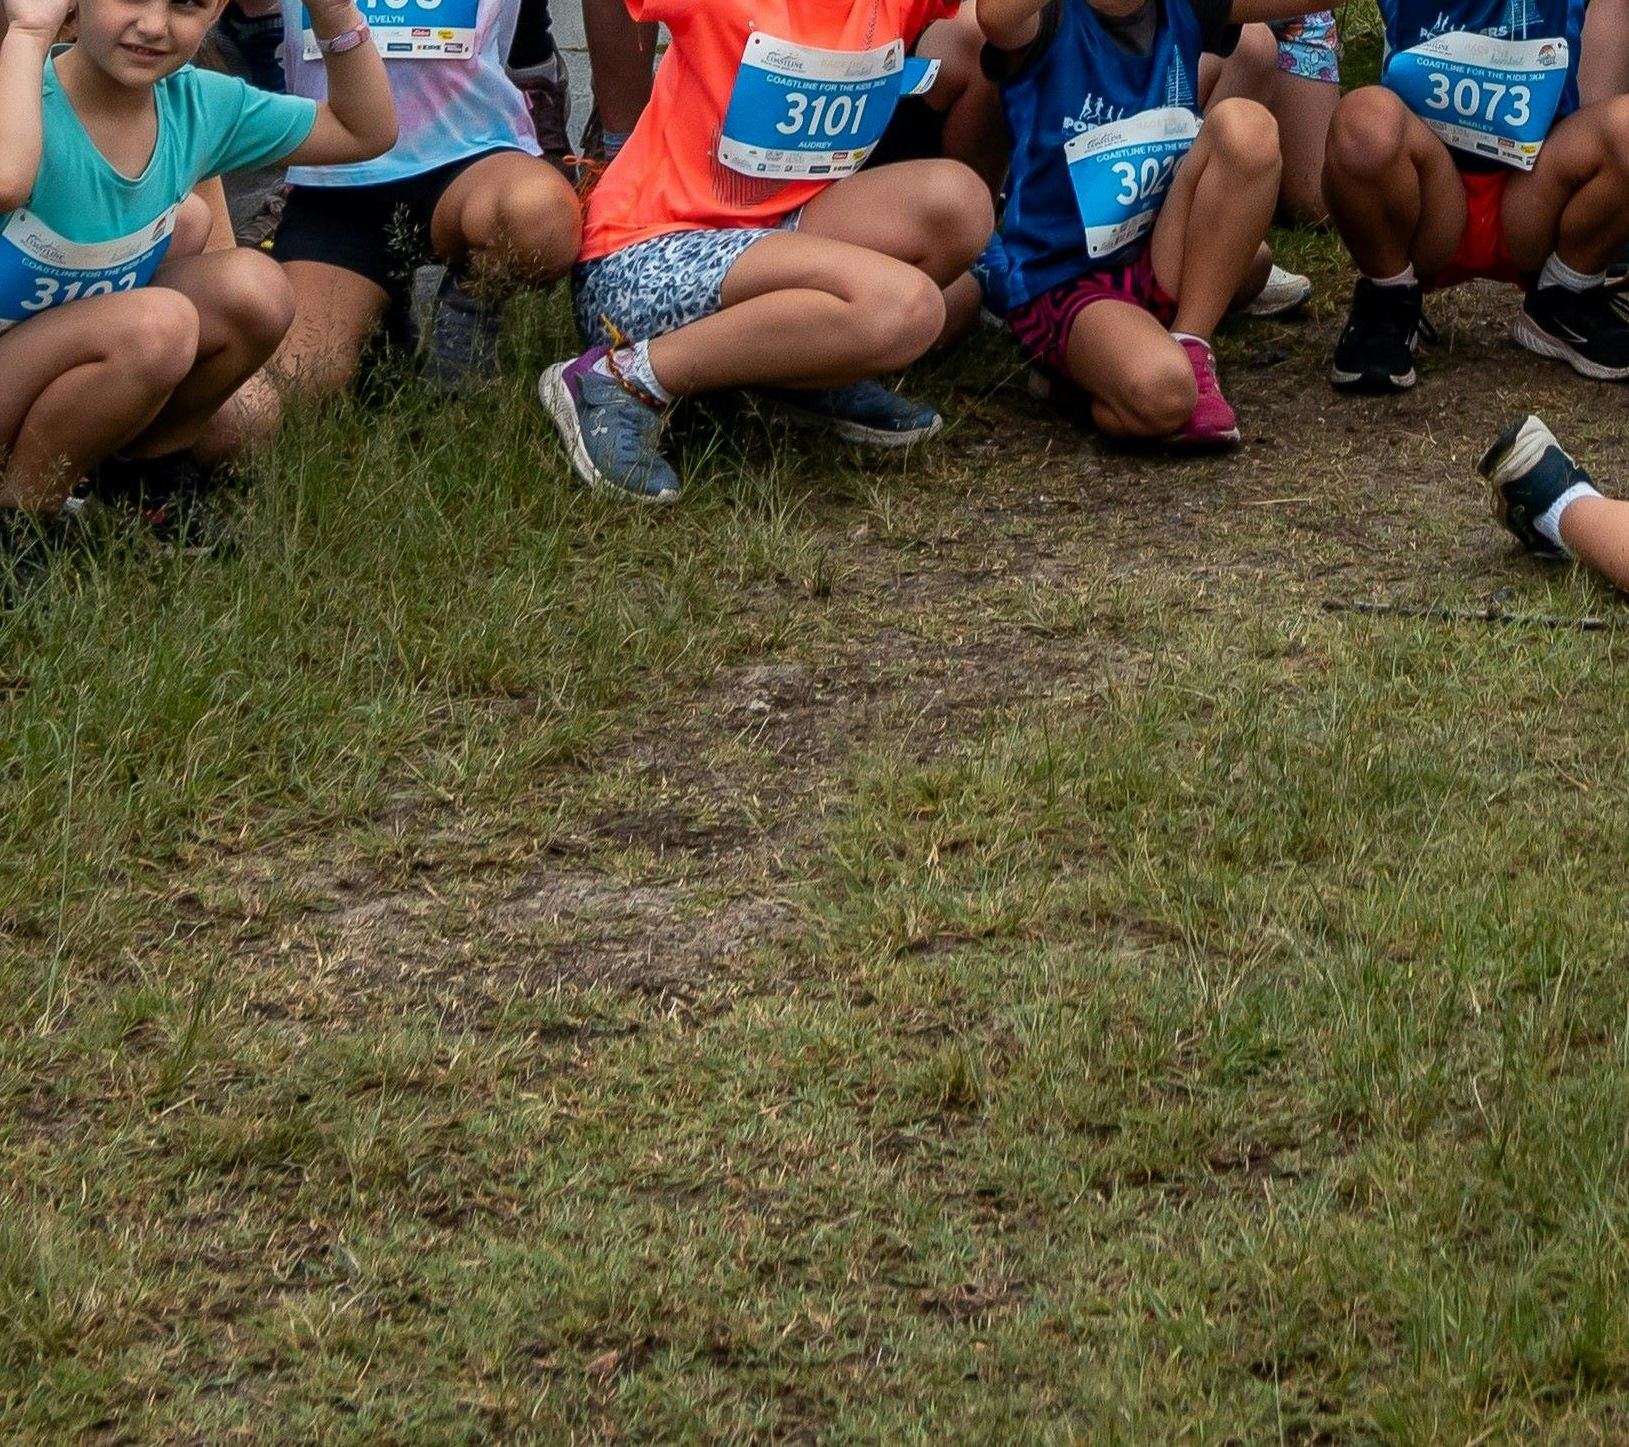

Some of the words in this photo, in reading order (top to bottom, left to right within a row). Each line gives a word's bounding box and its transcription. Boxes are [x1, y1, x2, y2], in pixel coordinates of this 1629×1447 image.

[368, 14, 404, 26] EVELYN
[1416, 57, 1465, 74] COASTLINE
[1467, 66, 1485, 76] FOR
[1487, 70, 1504, 79] THE
[766, 74, 818, 91] COASTLINE
[819, 83, 838, 92] FOR
[839, 83, 855, 92] THE
[1425, 73, 1531, 126] 3073
[776, 92, 867, 136] 3101
